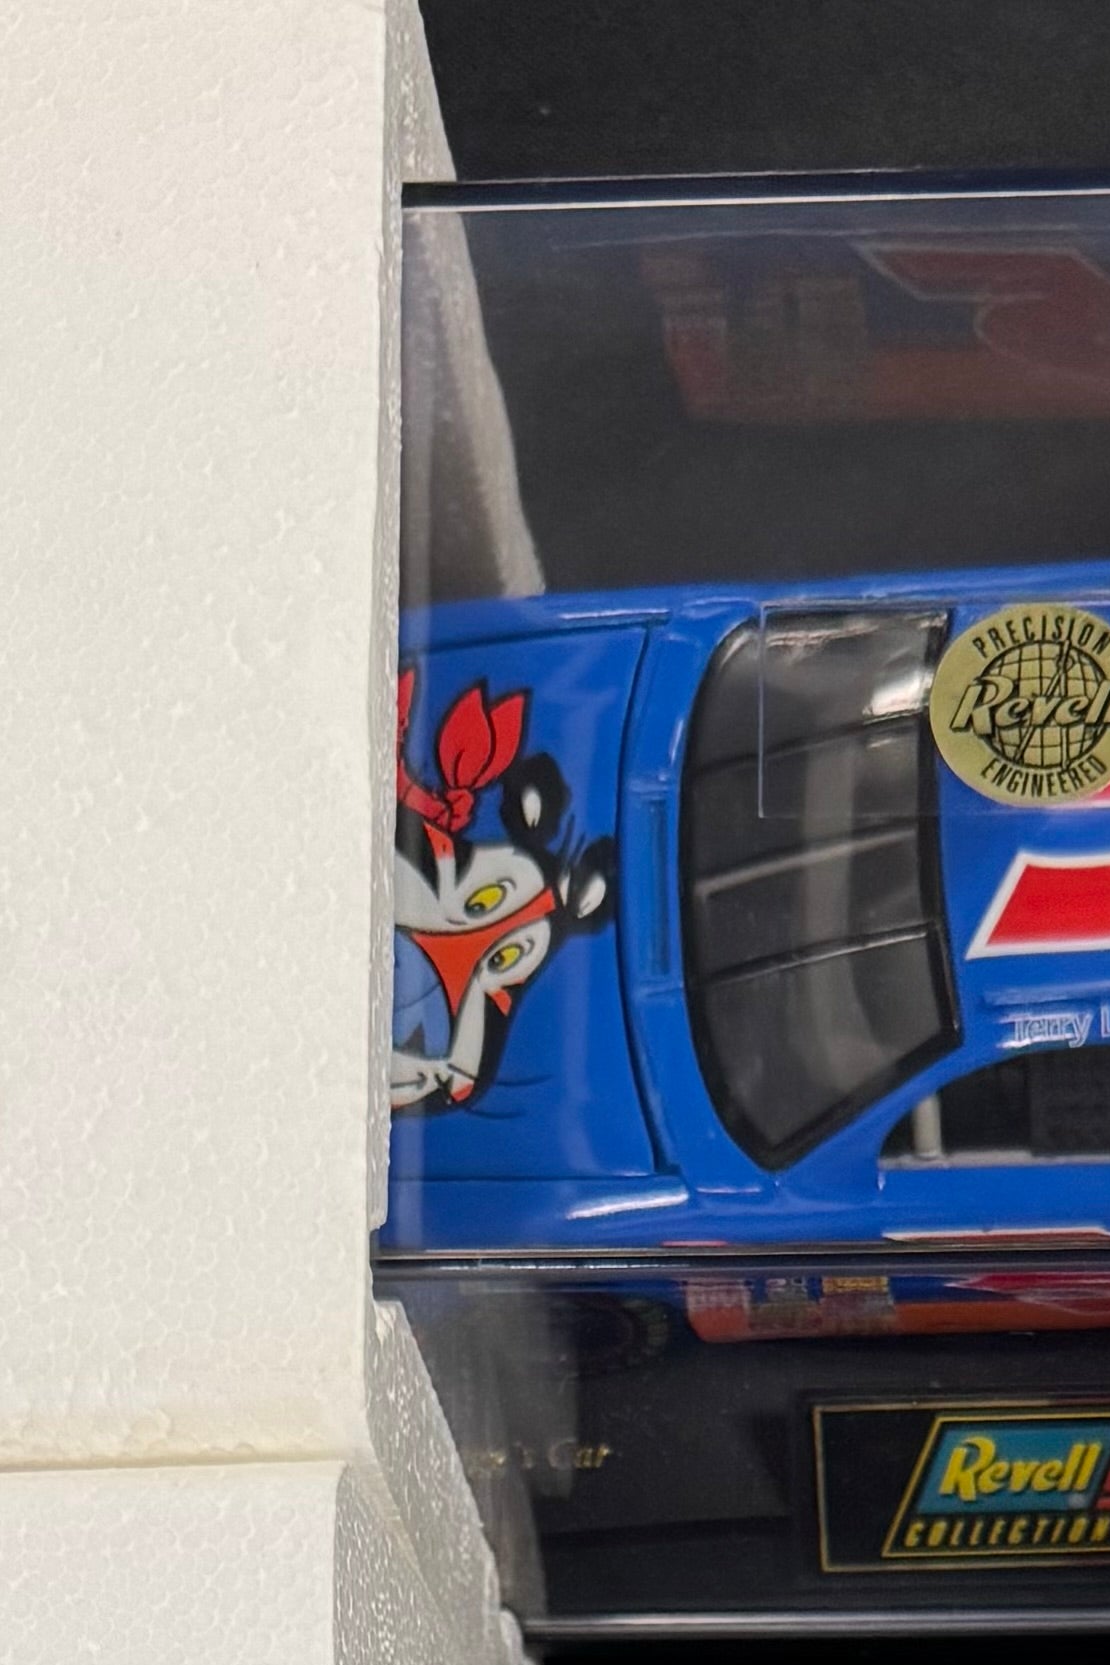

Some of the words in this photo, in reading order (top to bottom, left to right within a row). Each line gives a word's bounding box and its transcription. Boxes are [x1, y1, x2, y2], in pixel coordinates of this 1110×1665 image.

[981, 757, 1110, 798] ENGINEERED
[1010, 1011, 1092, 1046] Terry
[938, 1435, 1102, 1502] Revell
